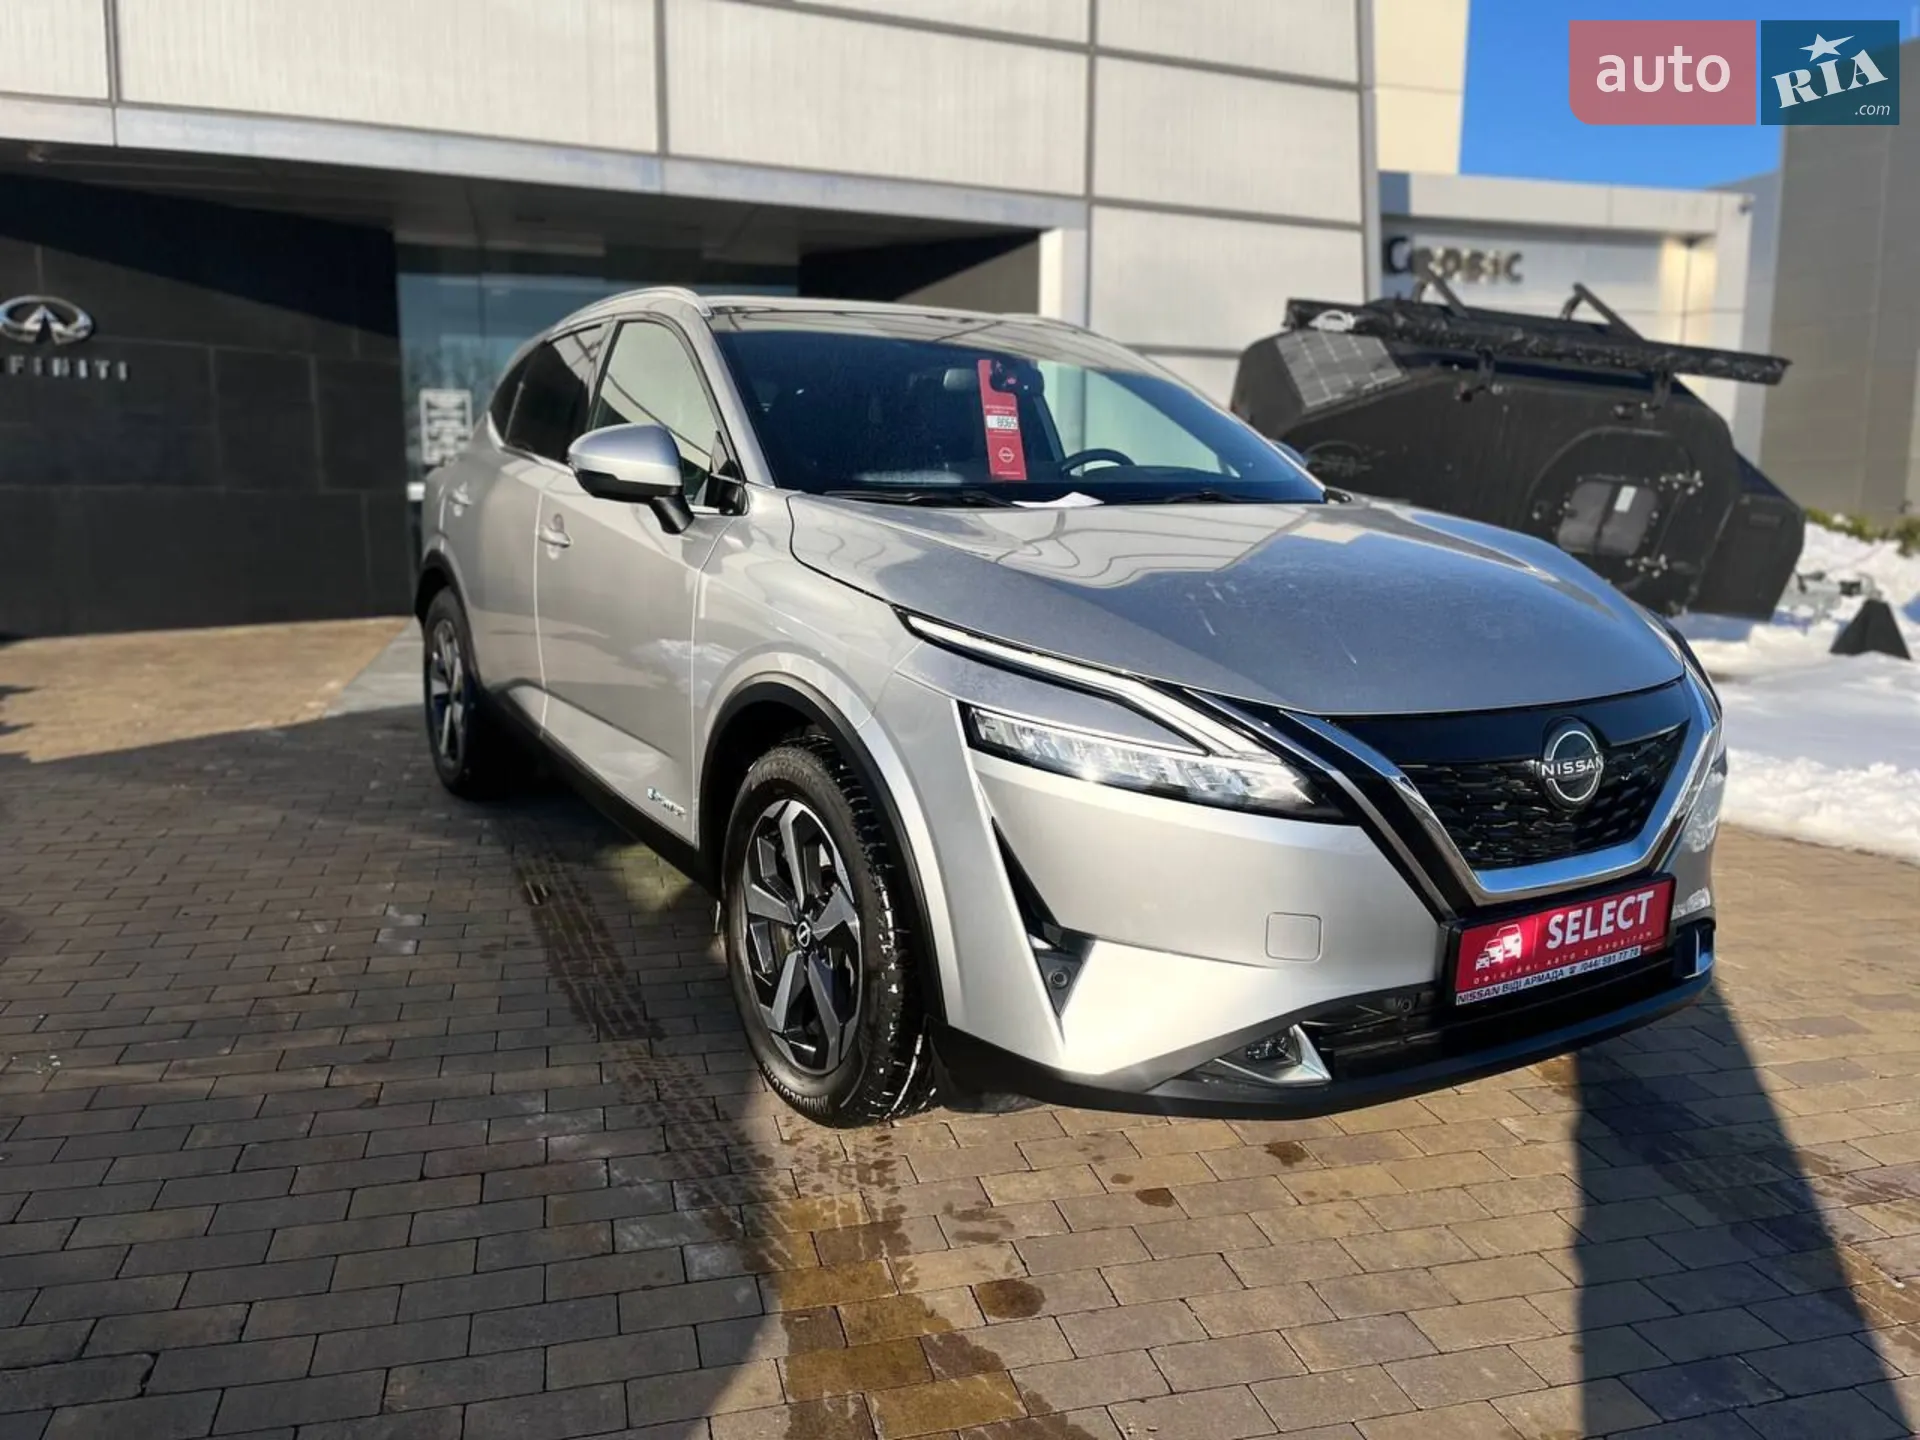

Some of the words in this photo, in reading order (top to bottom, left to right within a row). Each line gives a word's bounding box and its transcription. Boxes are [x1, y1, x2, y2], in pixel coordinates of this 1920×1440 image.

[1541, 754, 1604, 777] NISSAN
[1546, 891, 1655, 949] SELECT
[1458, 985, 1501, 1003] NISSAN
[1523, 968, 1564, 988] АРМАДА
